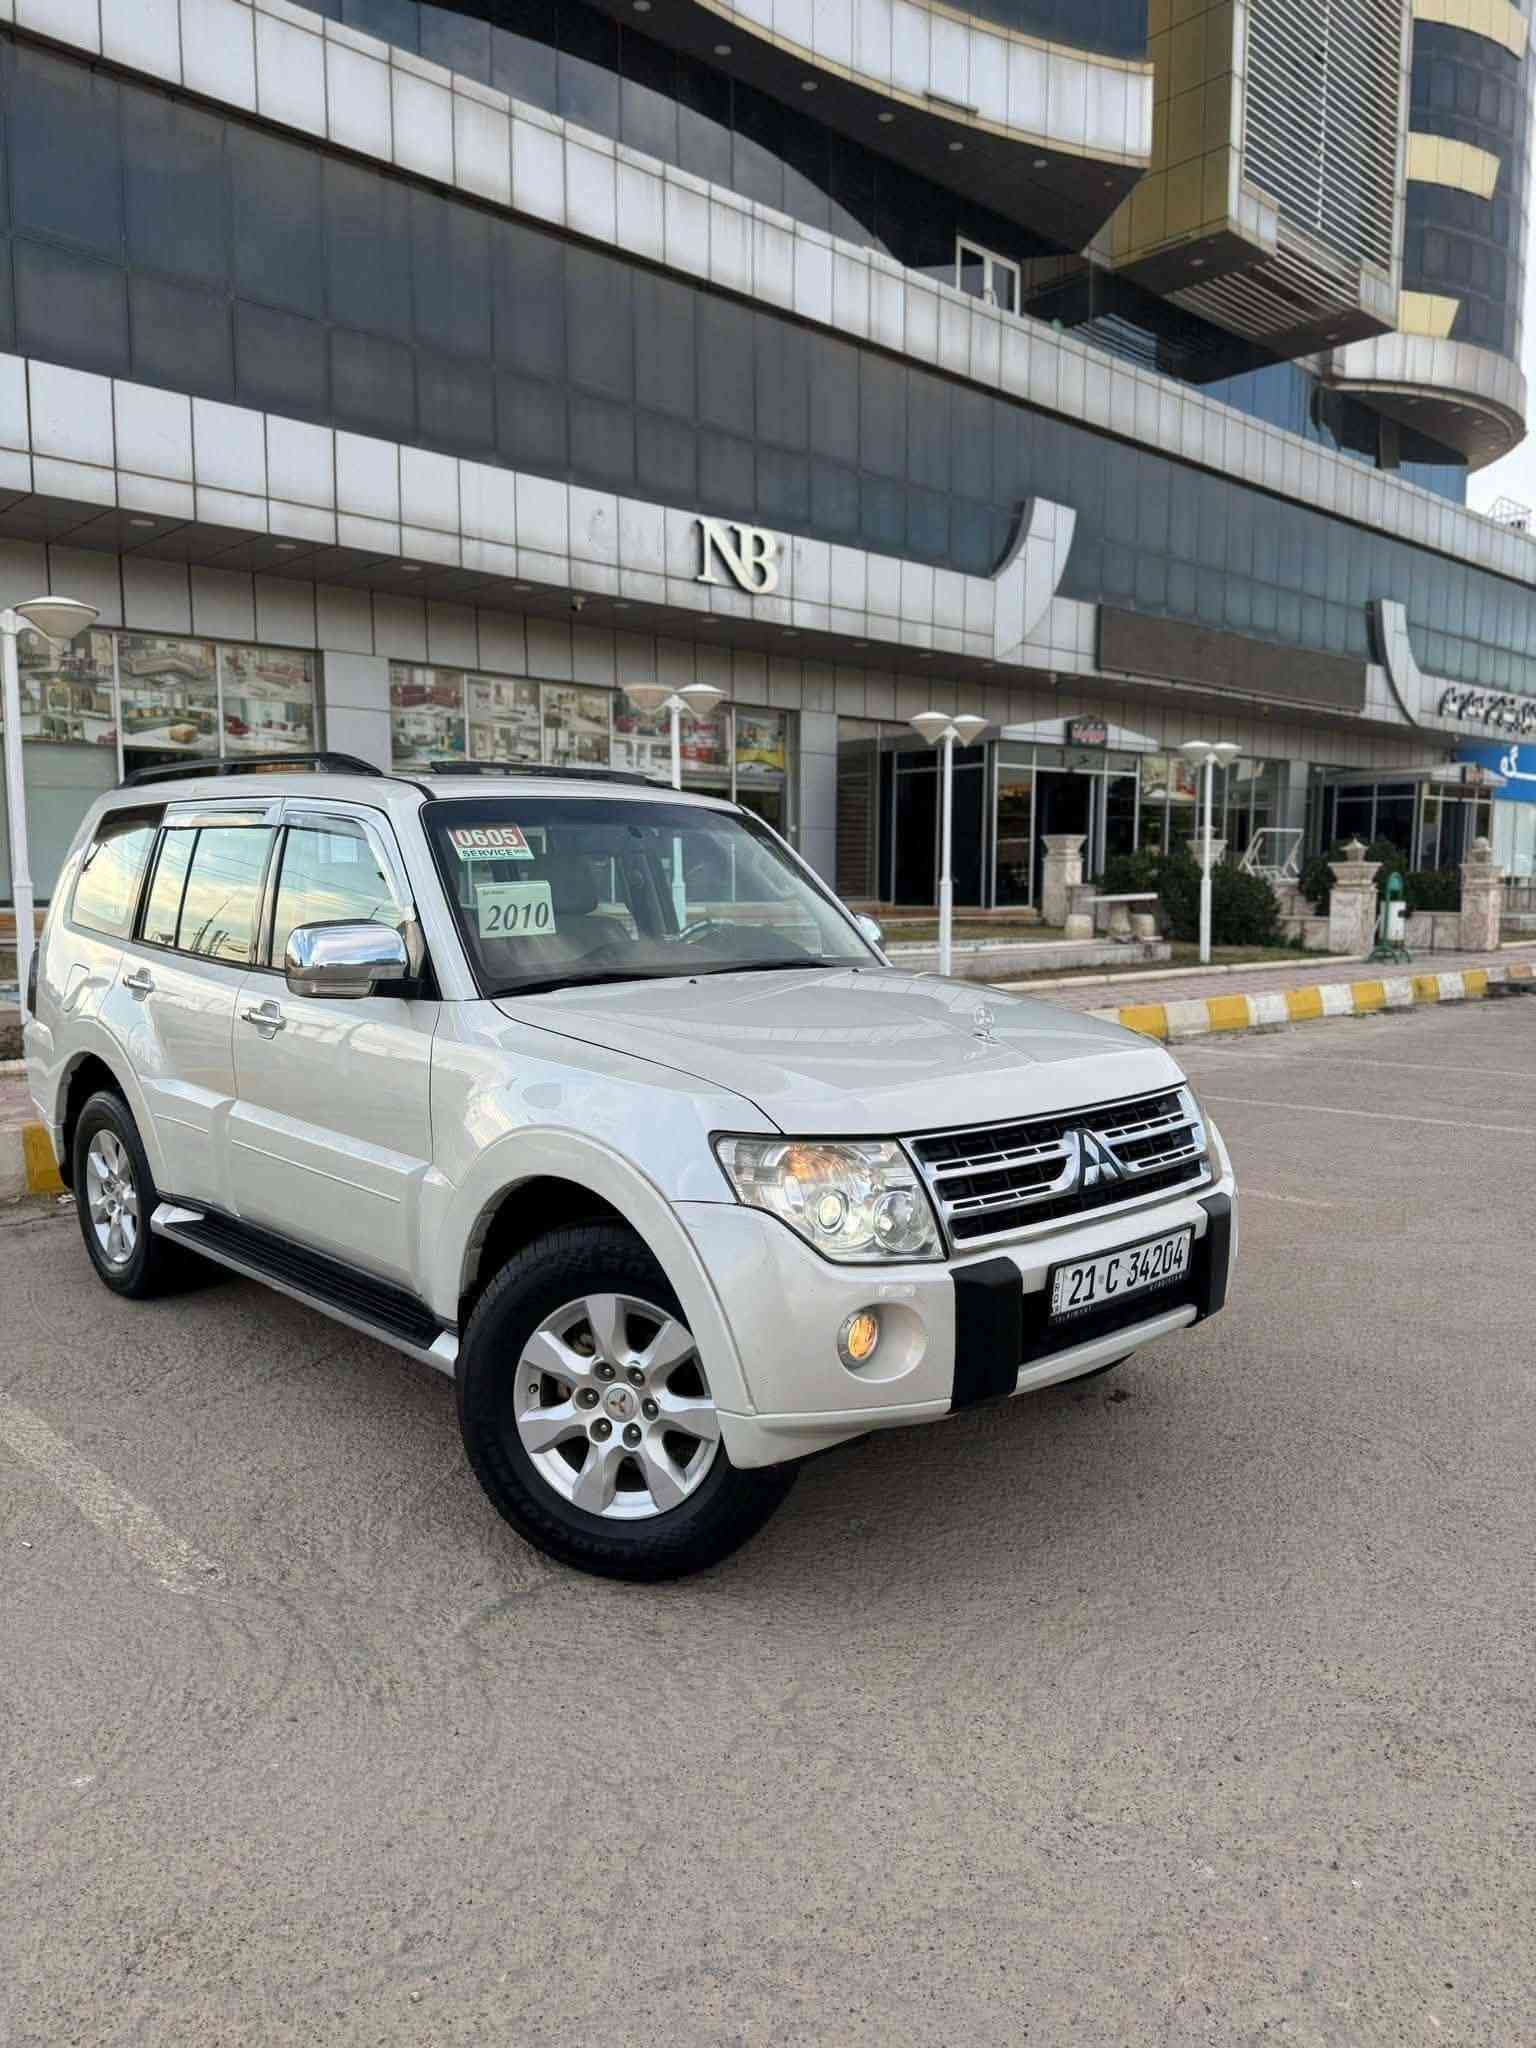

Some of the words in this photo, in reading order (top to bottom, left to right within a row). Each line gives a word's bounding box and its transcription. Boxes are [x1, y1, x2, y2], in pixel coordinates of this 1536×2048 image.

[696, 518, 779, 595] NB
[455, 828, 519, 847] 0605
[462, 848, 513, 857] SERVICE
[485, 902, 549, 931] 2010
[1068, 1265, 1096, 1306] 21
[1105, 1258, 1120, 1294] C
[1126, 1237, 1184, 1288] 34204
